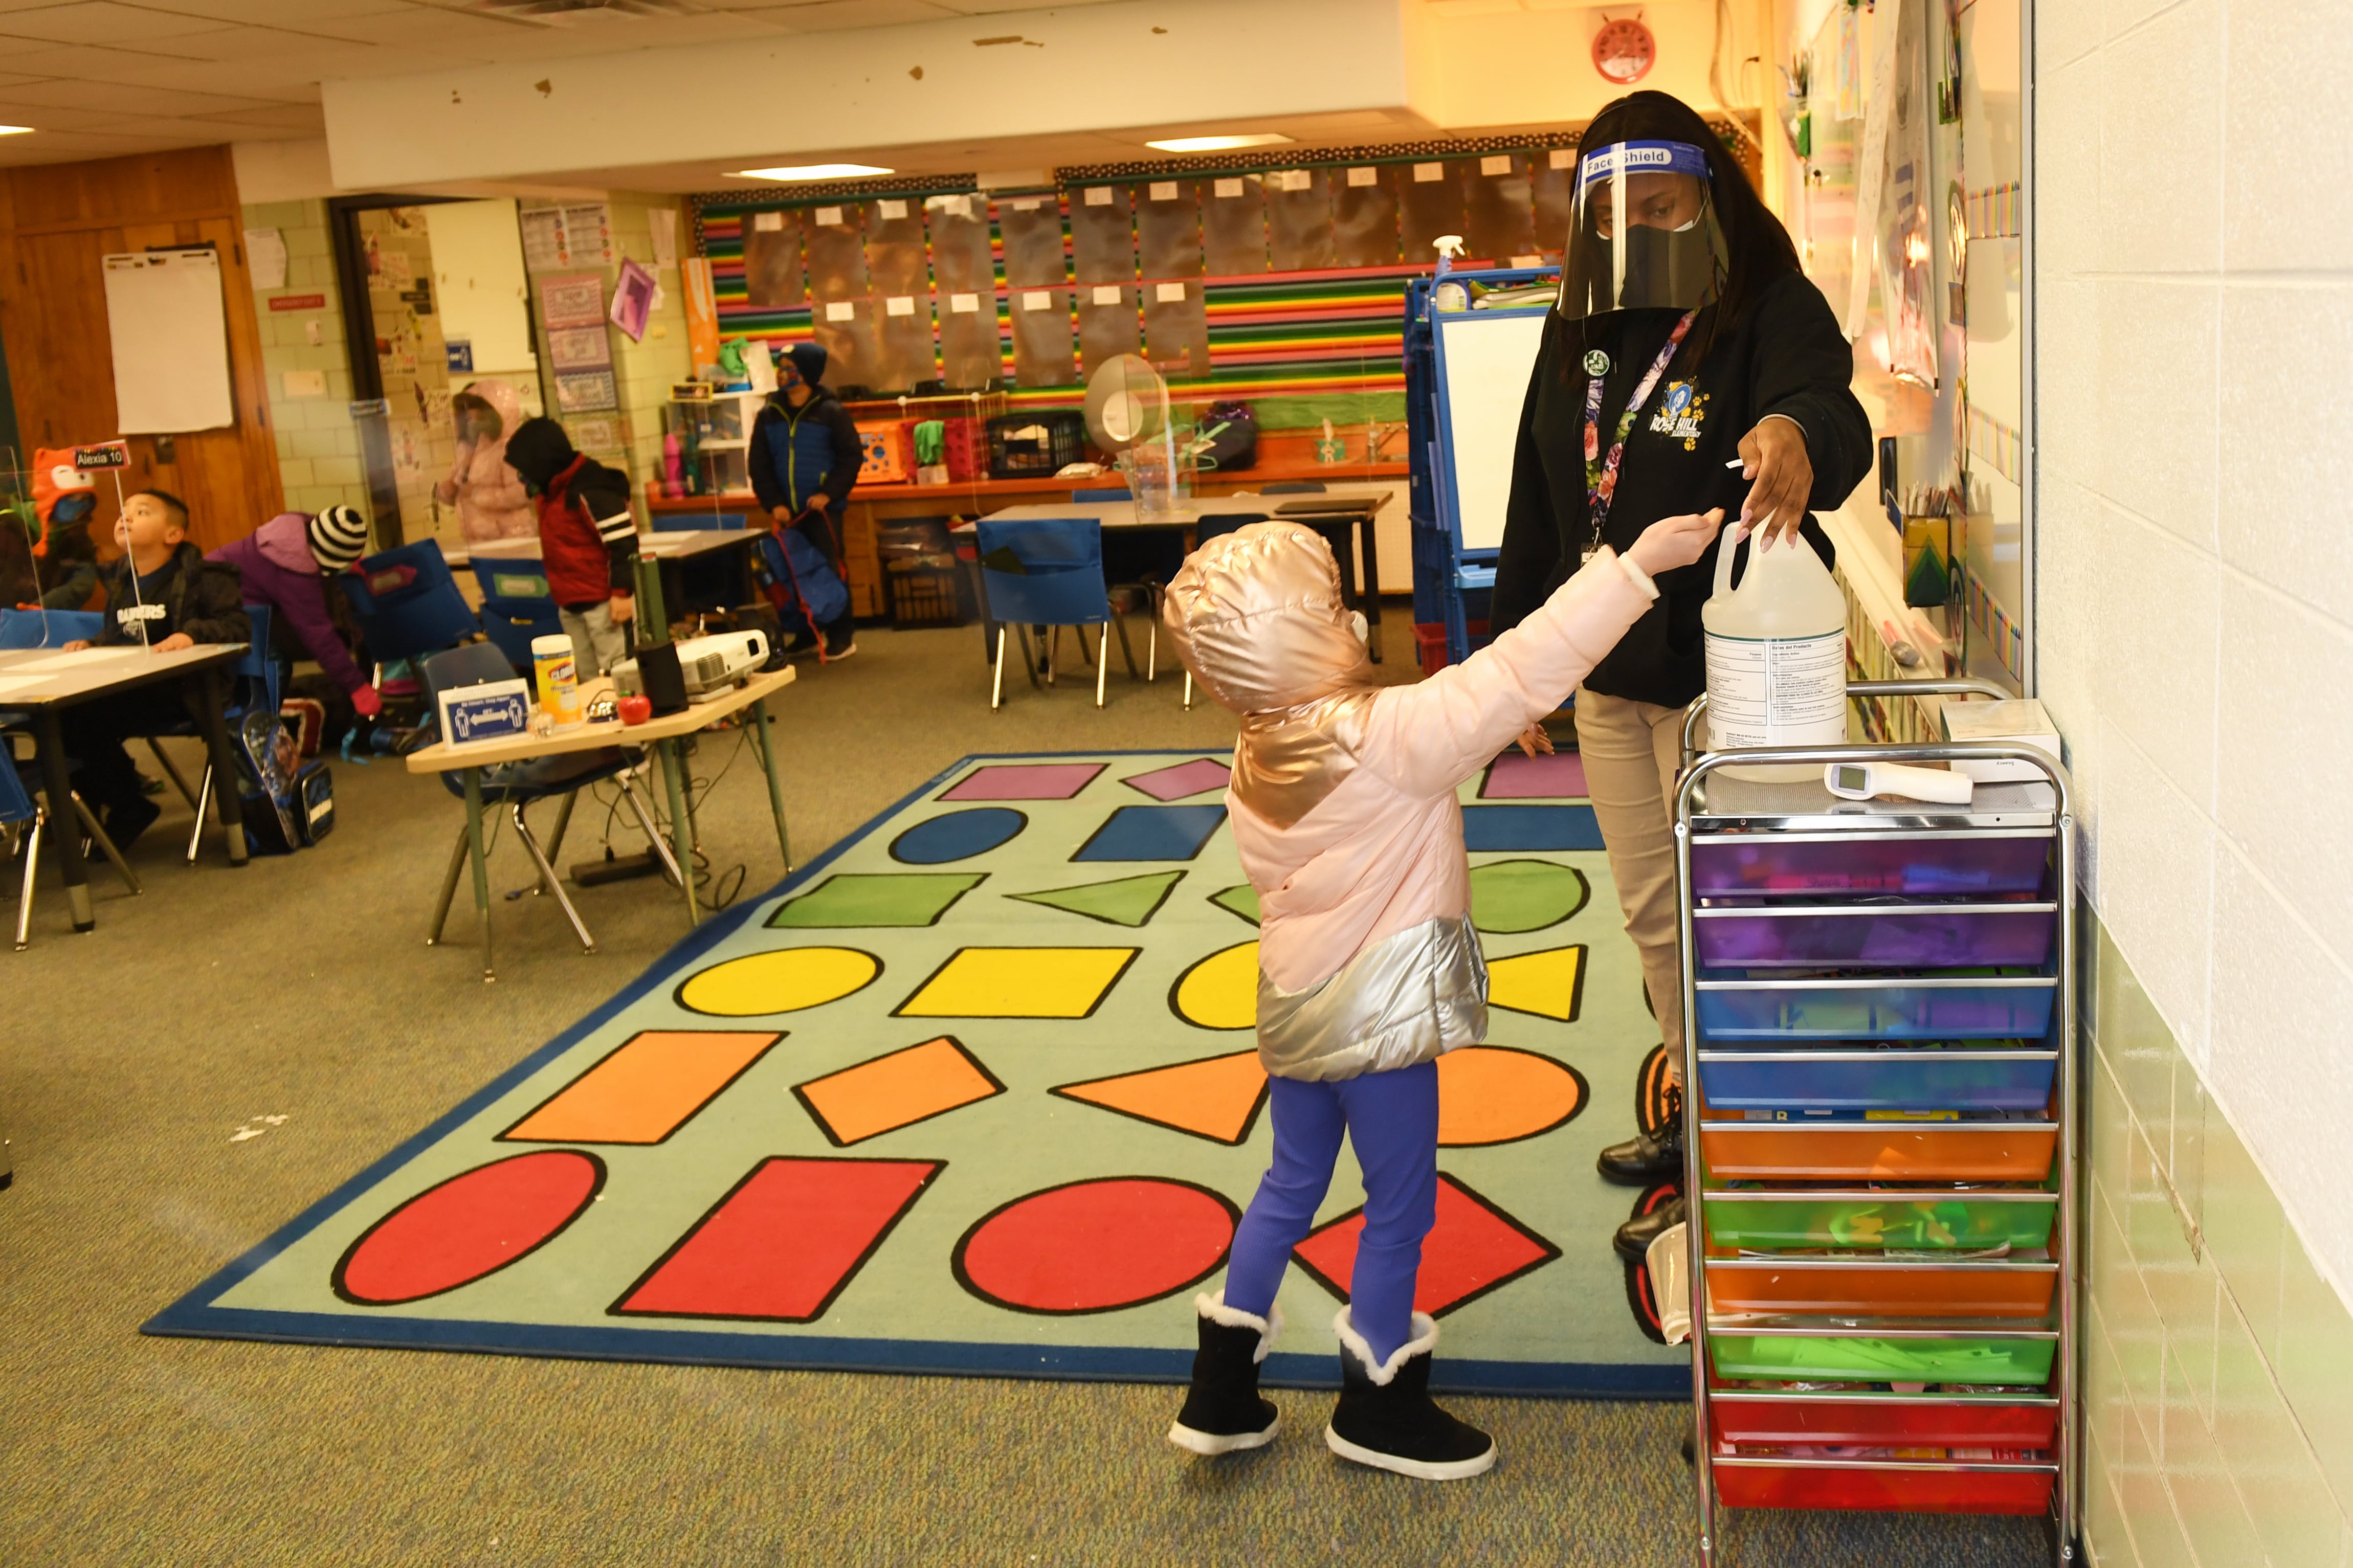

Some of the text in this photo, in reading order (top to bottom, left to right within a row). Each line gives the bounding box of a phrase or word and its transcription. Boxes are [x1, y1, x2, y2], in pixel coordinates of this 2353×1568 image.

[1587, 157, 1613, 173] Face
[1623, 150, 1664, 164] Shield
[1649, 416, 1699, 432] ROSE HILL
[77, 450, 122, 465] Alexia 10
